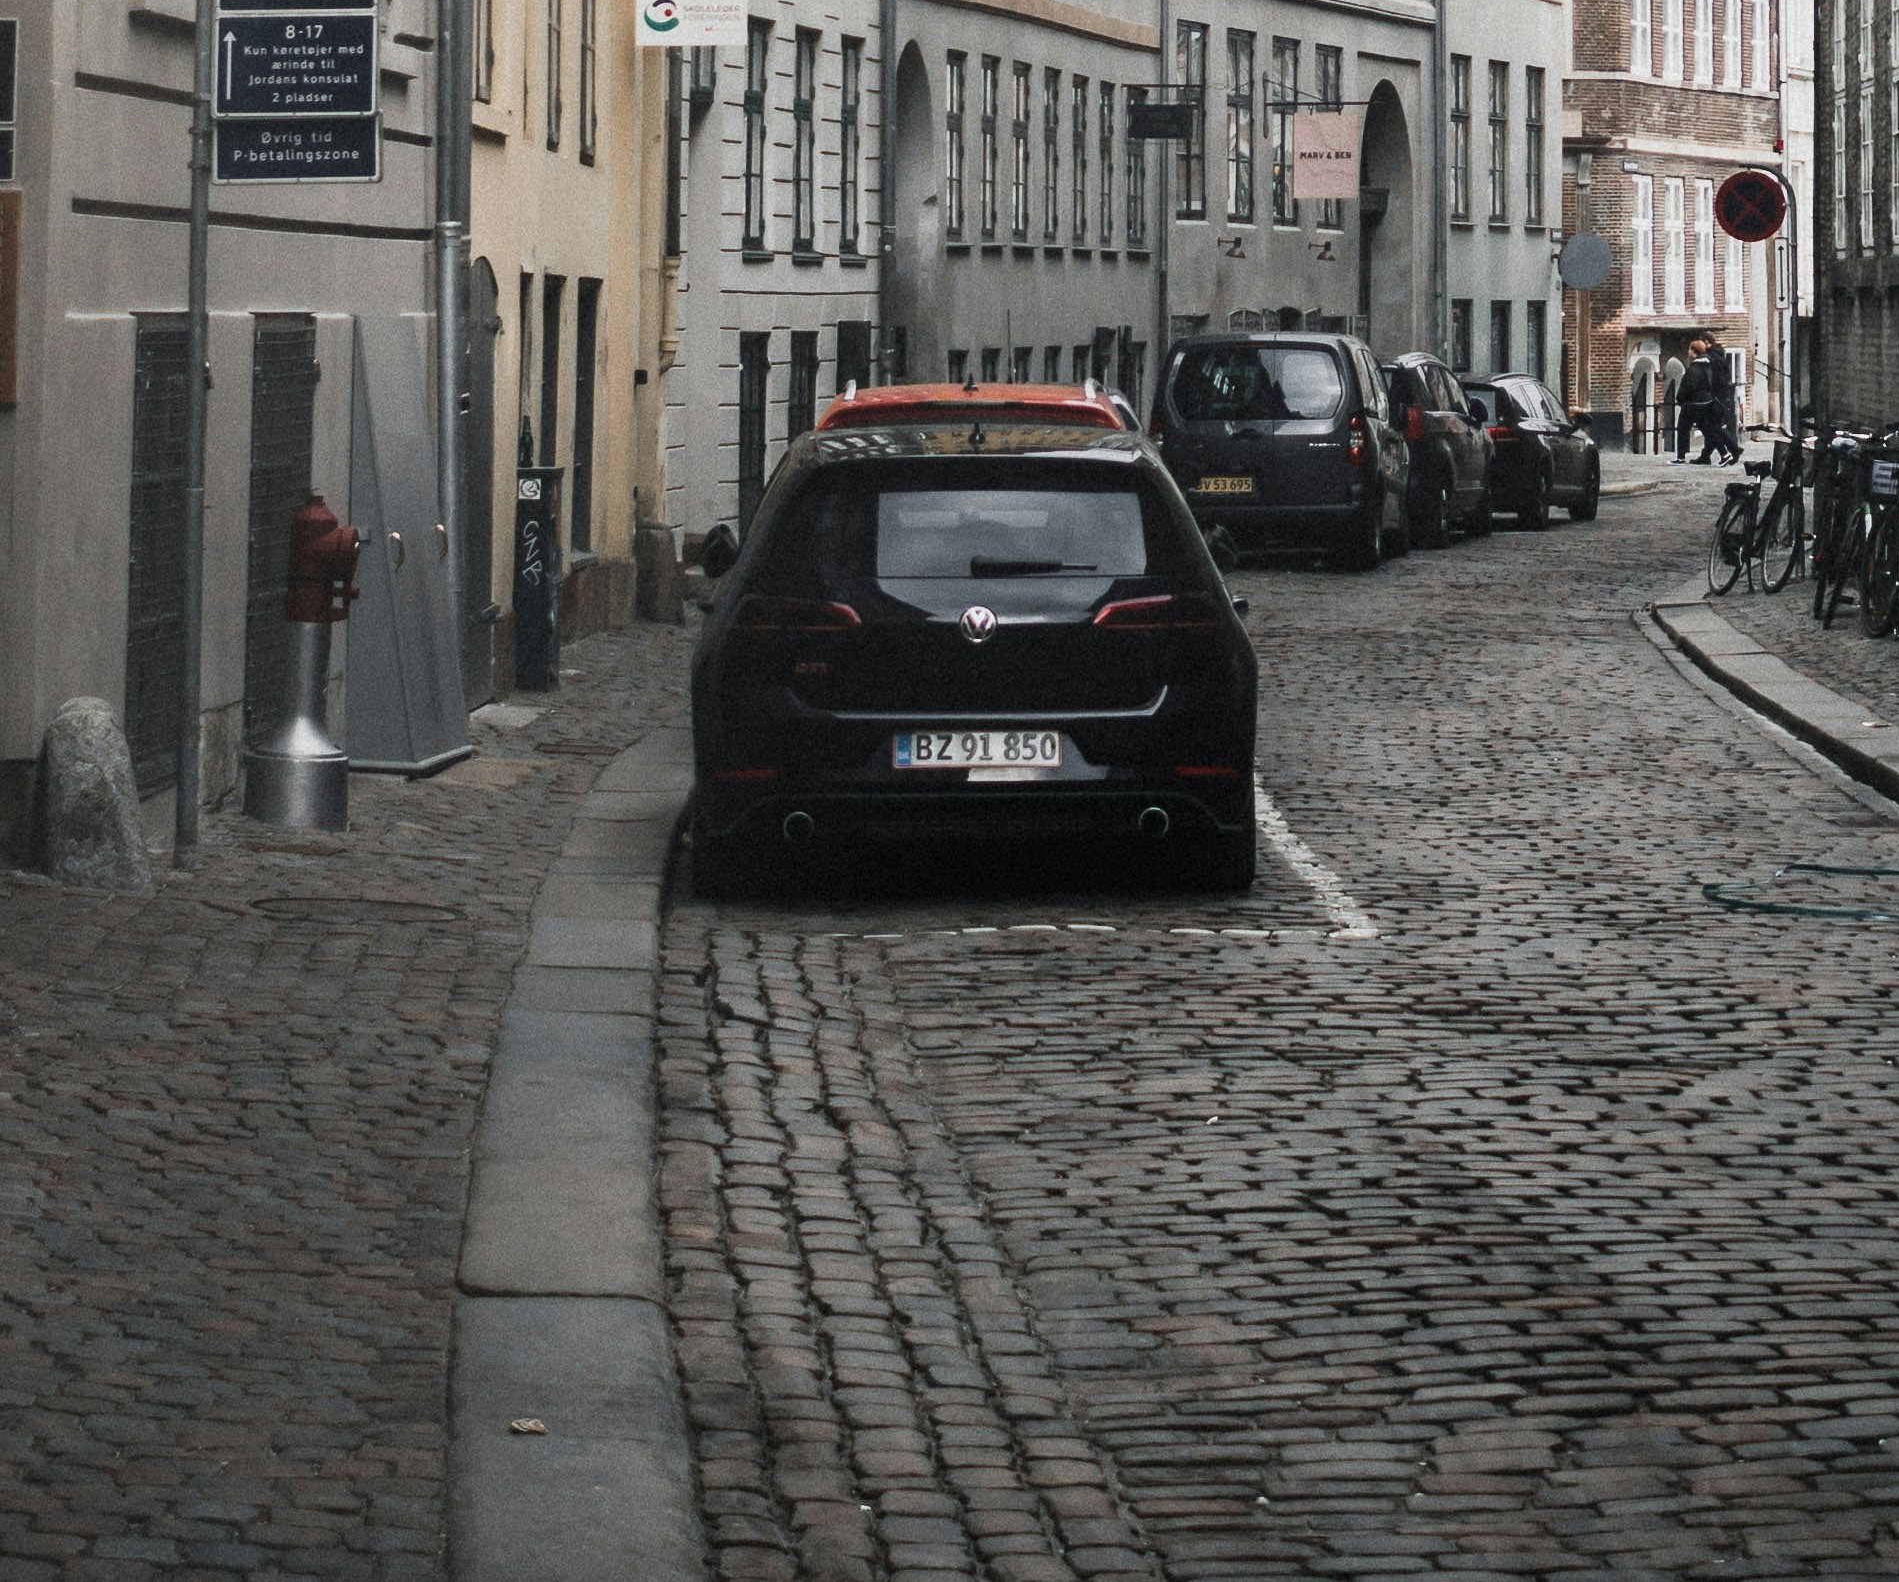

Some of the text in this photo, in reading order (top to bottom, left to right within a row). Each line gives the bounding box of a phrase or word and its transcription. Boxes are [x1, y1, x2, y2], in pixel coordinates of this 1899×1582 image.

[285, 25, 324, 39] 8-17
[244, 45, 364, 56] Kun køretøjer med
[272, 59, 335, 70] ærinde til
[248, 74, 358, 86] Jordans konsulat
[272, 92, 334, 103] 2 pladser
[261, 131, 332, 145] Øvrig tid
[234, 149, 360, 163] P-betalingszone
[1213, 479, 1227, 491] 53
[1230, 478, 1250, 490] 695
[916, 734, 953, 761] BZ
[961, 733, 993, 761] 91
[1003, 733, 1056, 761] 850
